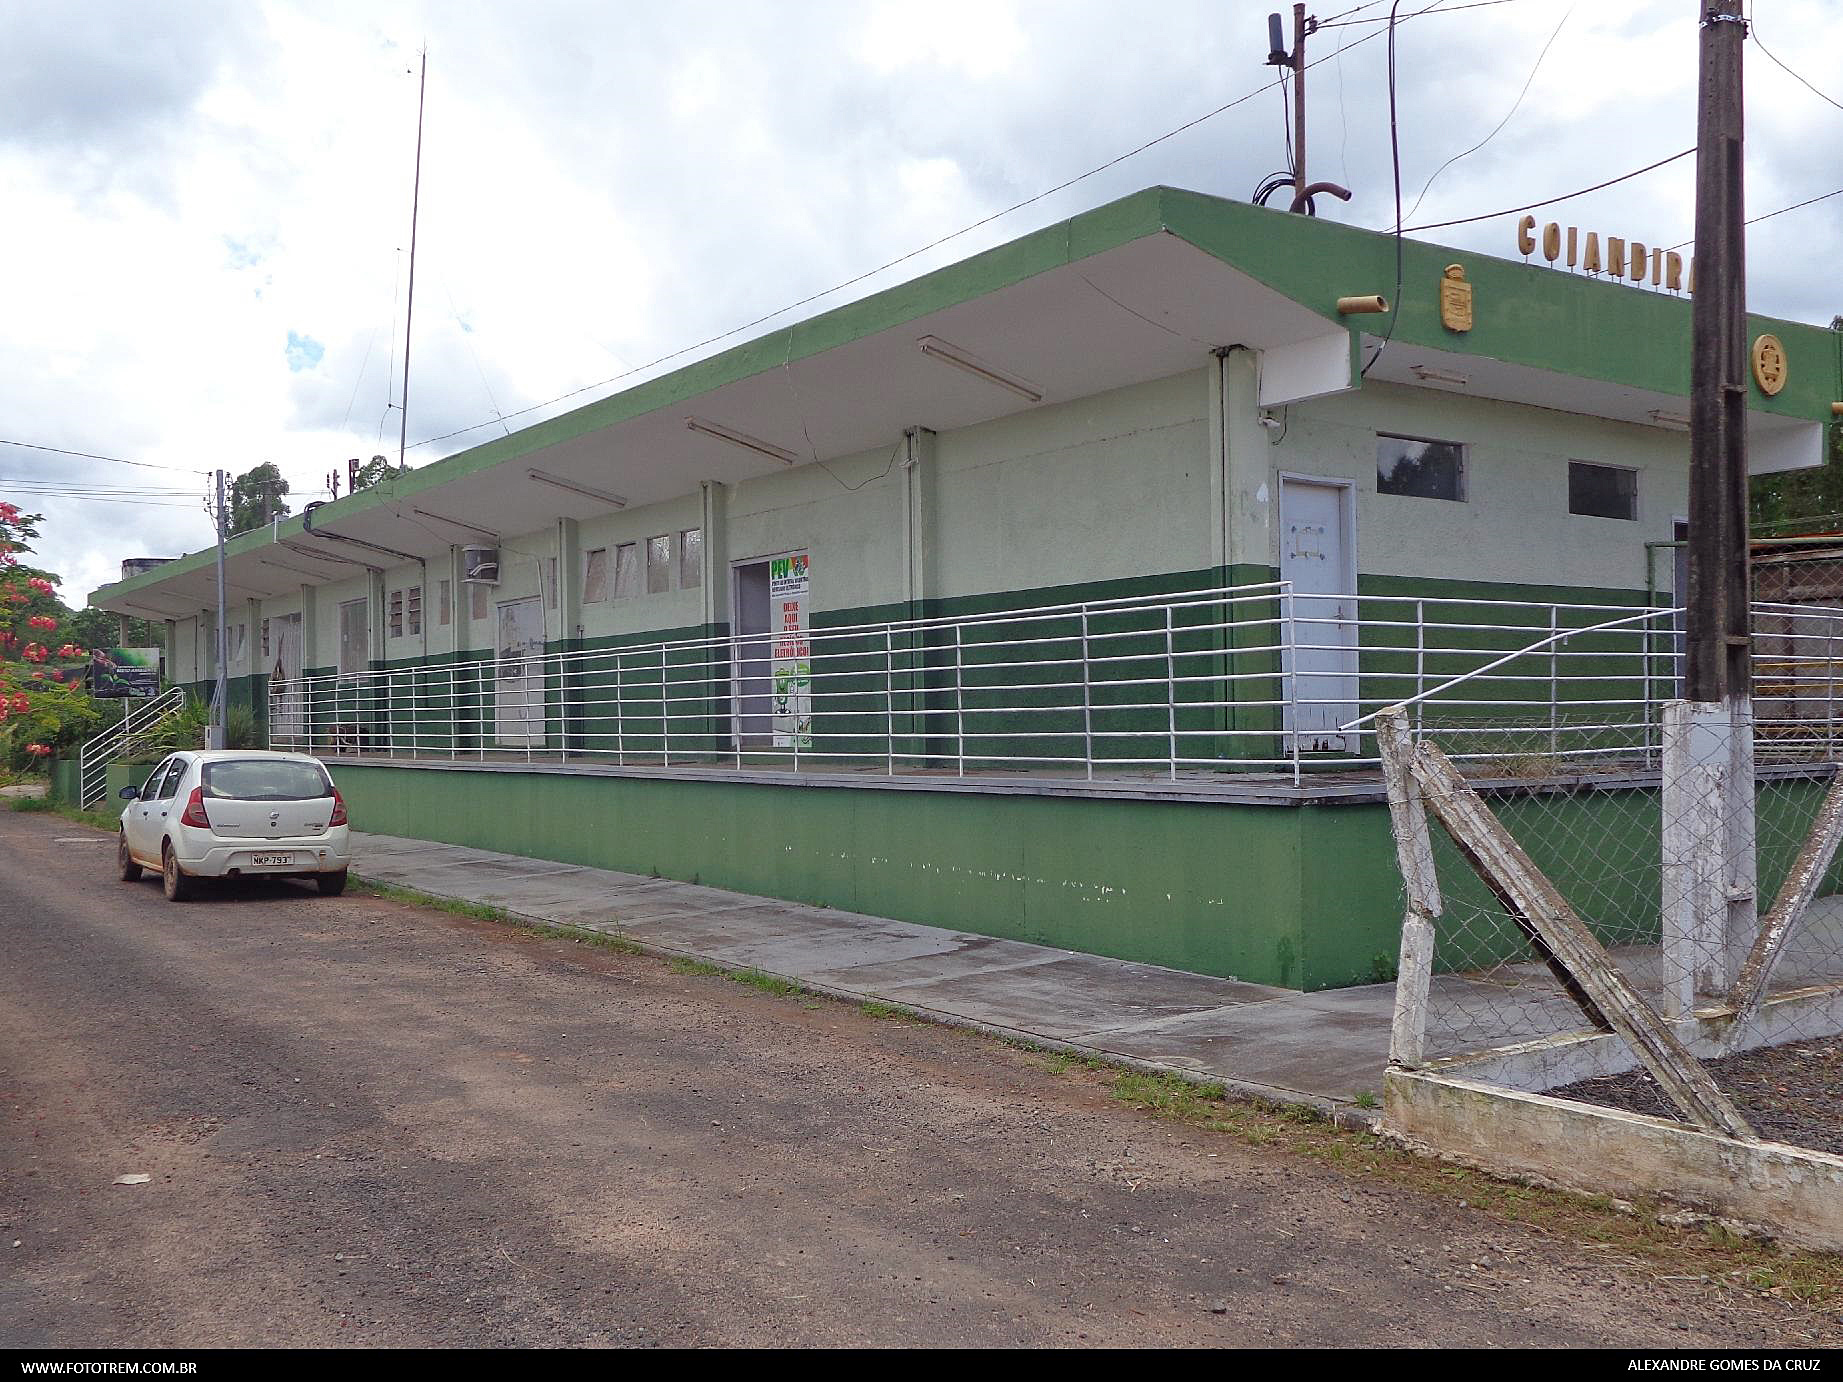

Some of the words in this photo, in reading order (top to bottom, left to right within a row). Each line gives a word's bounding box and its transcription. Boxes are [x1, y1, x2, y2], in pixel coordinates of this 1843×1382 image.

[772, 559, 789, 580] PEV
[783, 601, 799, 612] DEIXE
[784, 612, 798, 624] AQUI
[253, 856, 291, 864] NKP-793
